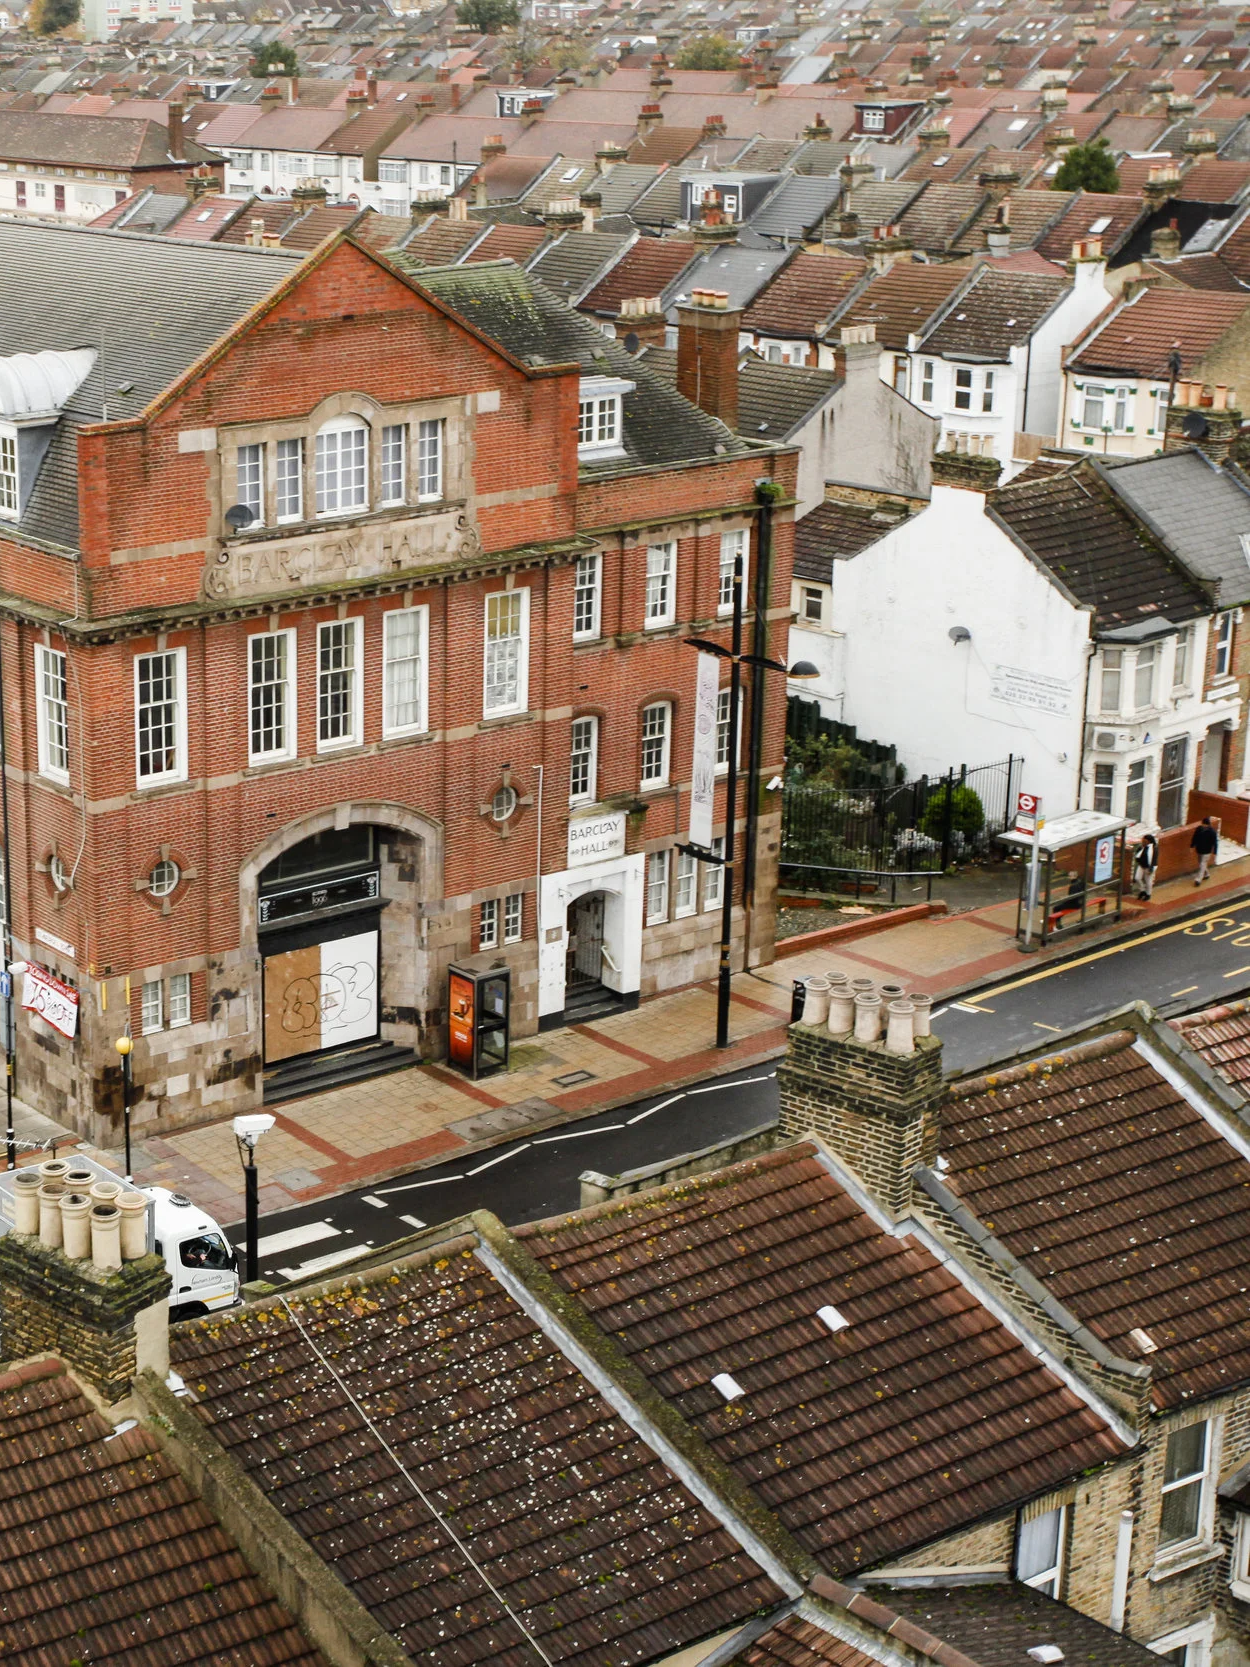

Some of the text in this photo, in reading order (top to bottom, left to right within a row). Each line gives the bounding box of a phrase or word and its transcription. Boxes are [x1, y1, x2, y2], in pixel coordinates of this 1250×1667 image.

[237, 536, 365, 585] BARCLAY
[570, 820, 620, 841] BARCLAY
[581, 841, 608, 856] HALL
